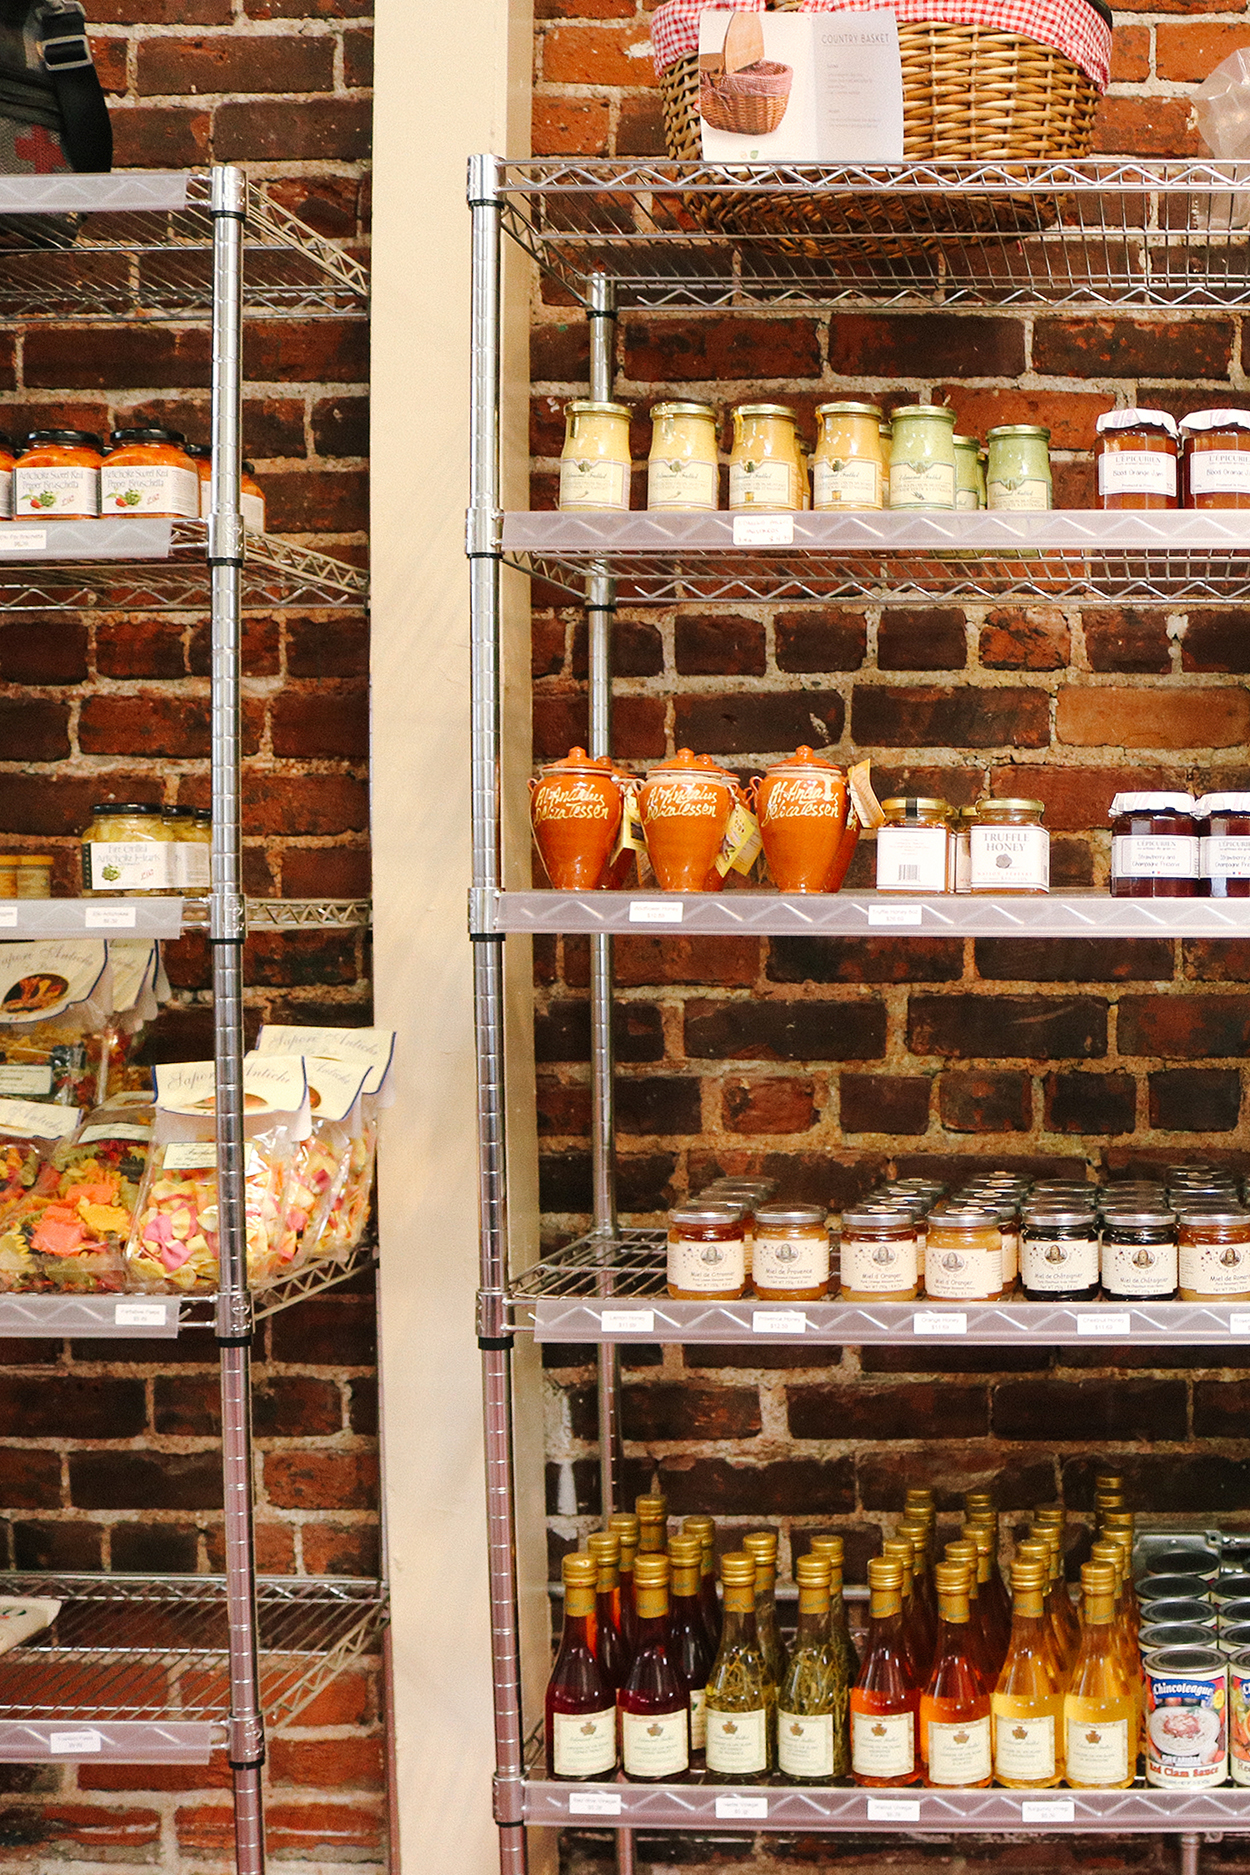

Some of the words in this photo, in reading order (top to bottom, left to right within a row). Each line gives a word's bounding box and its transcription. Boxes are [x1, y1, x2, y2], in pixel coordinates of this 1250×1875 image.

[821, 34, 858, 44] COUNTRY
[861, 33, 890, 43] BASKET
[643, 801, 717, 825] Delicatessen
[983, 833, 1030, 842] TRUFFLE
[986, 842, 1026, 852] HONEY
[1153, 1682, 1215, 1696] Chincoteague
[1162, 1754, 1201, 1764] PREMIUM
[1164, 1768, 1189, 1778] Clam
[1193, 1766, 1219, 1777] Sauce
